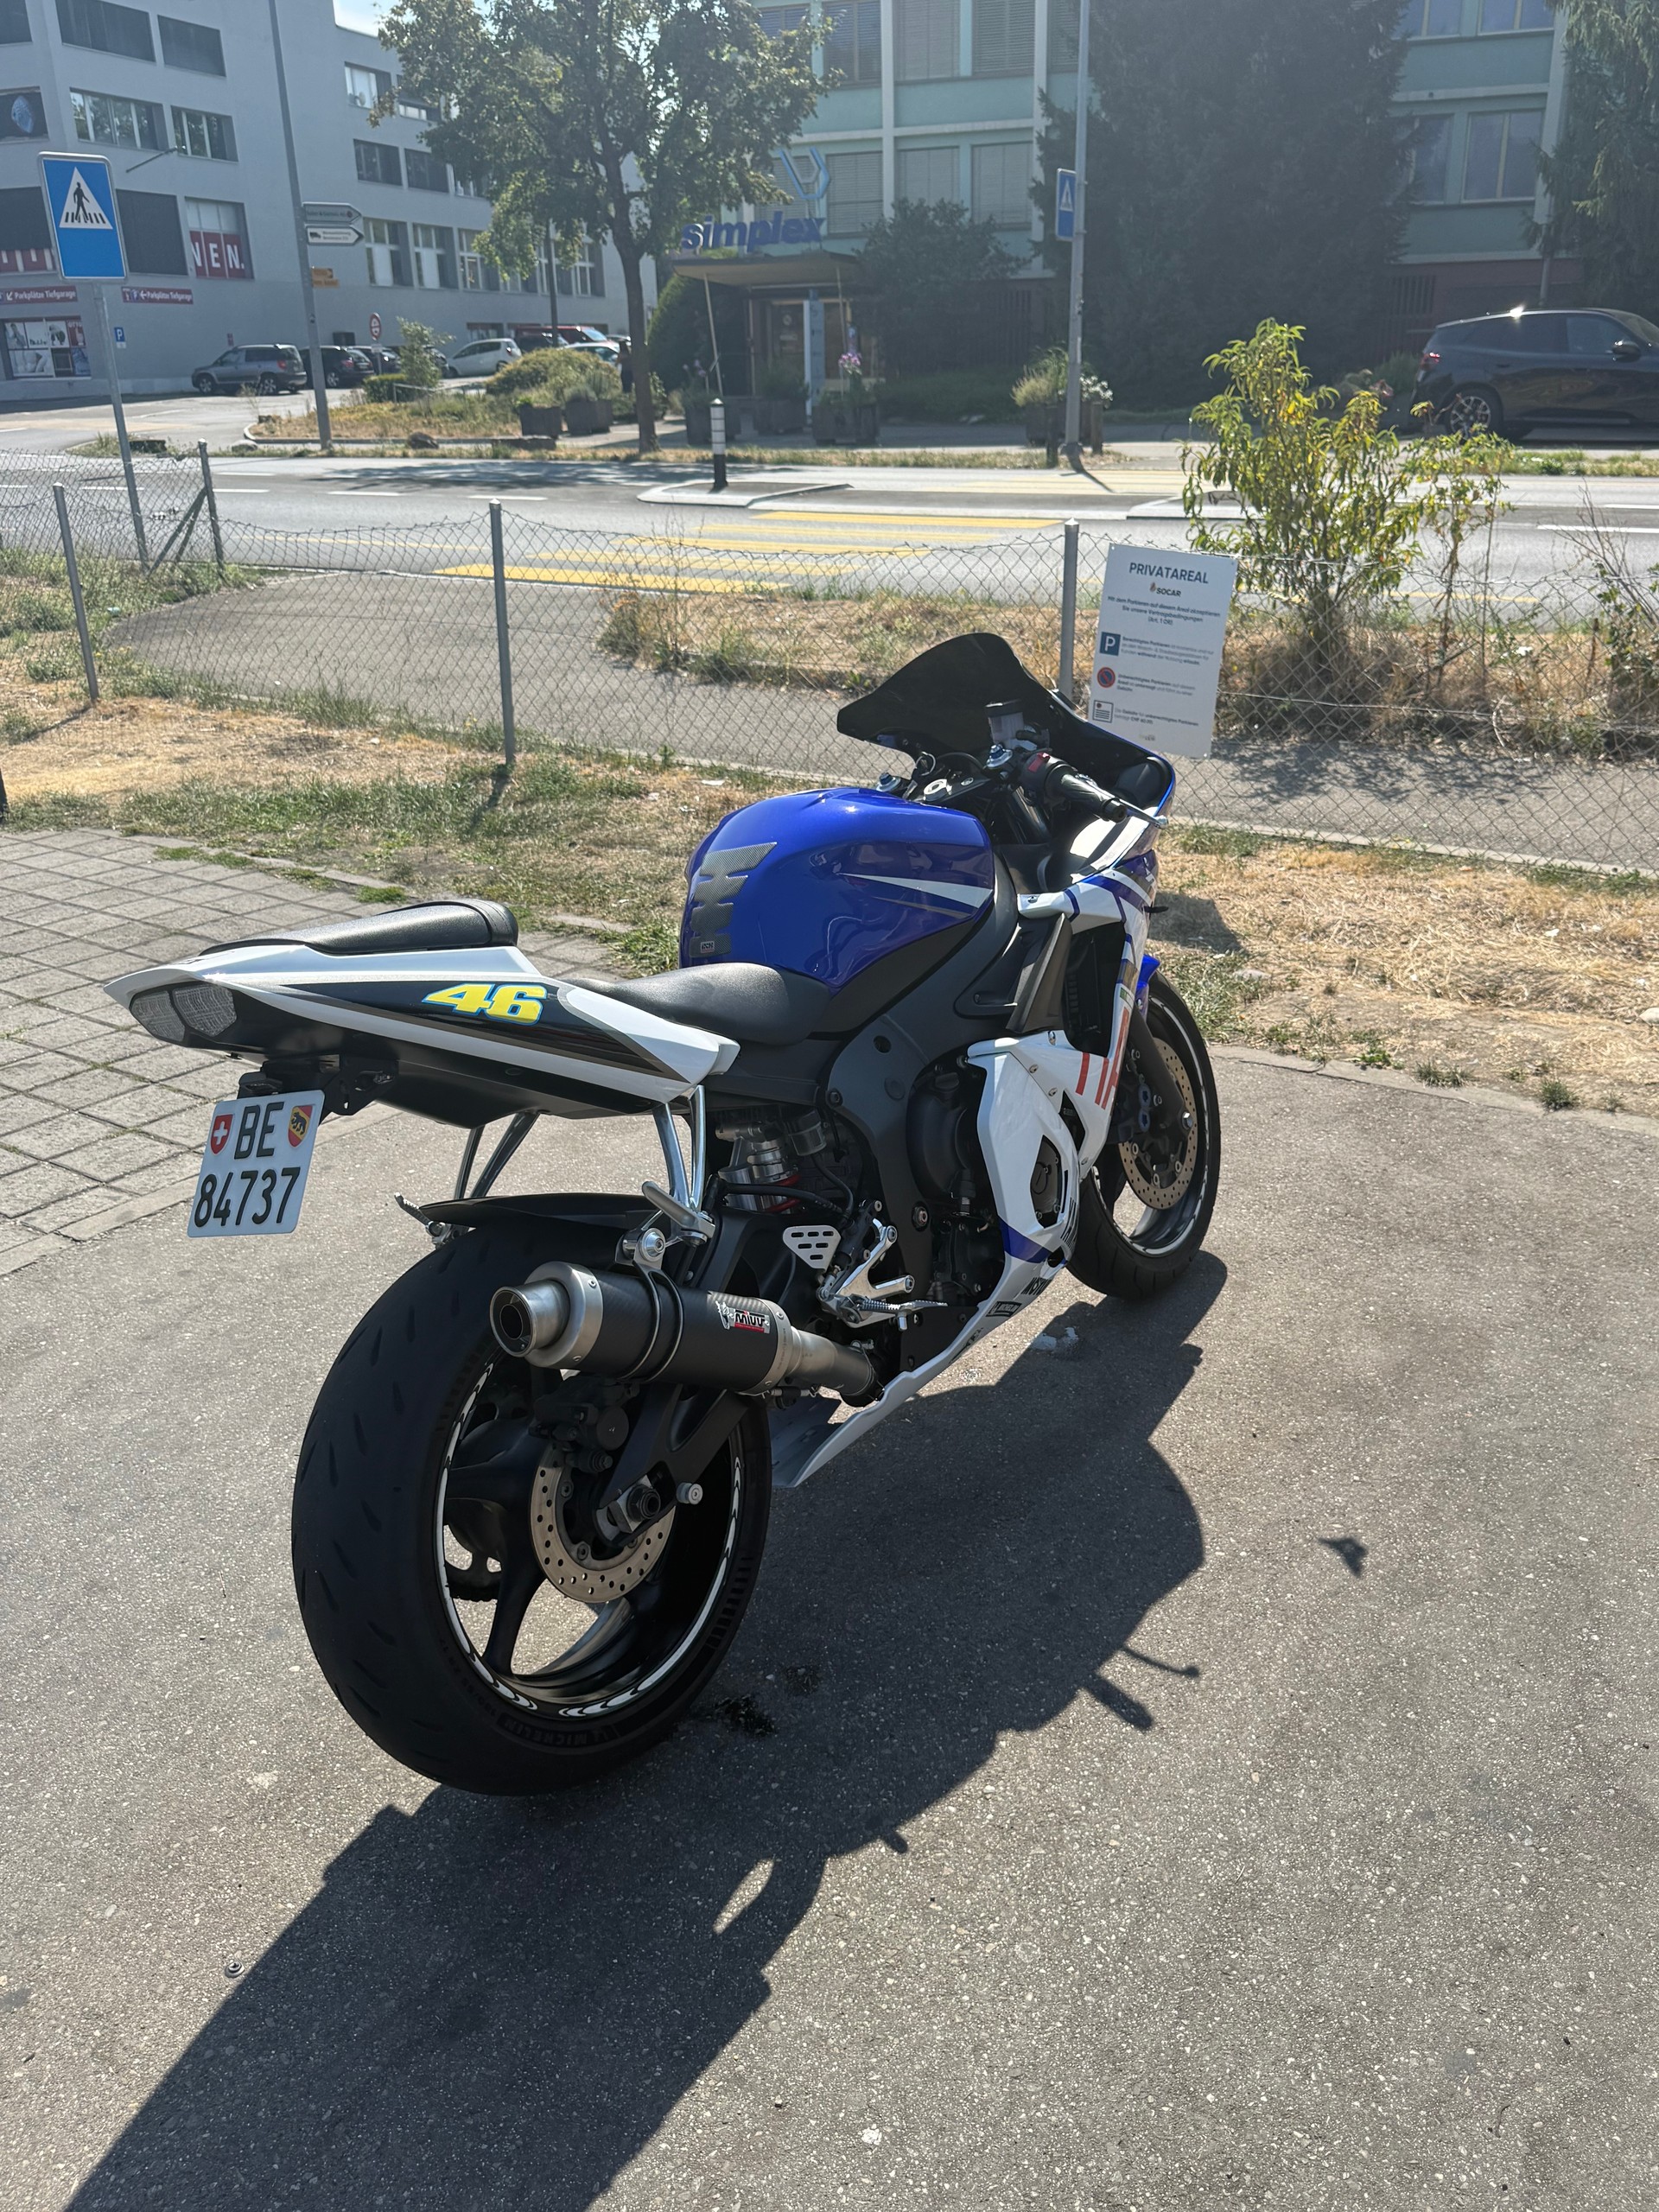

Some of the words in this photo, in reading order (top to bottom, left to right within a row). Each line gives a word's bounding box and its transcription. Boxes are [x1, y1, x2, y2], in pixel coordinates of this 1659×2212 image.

[681, 211, 826, 252] simplex
[1128, 562, 1209, 584] PRIVATAREAL
[1156, 588, 1181, 597] SOCAR
[422, 982, 548, 1026] 46
[234, 1101, 285, 1160] BE
[194, 1166, 302, 1228] 84737
